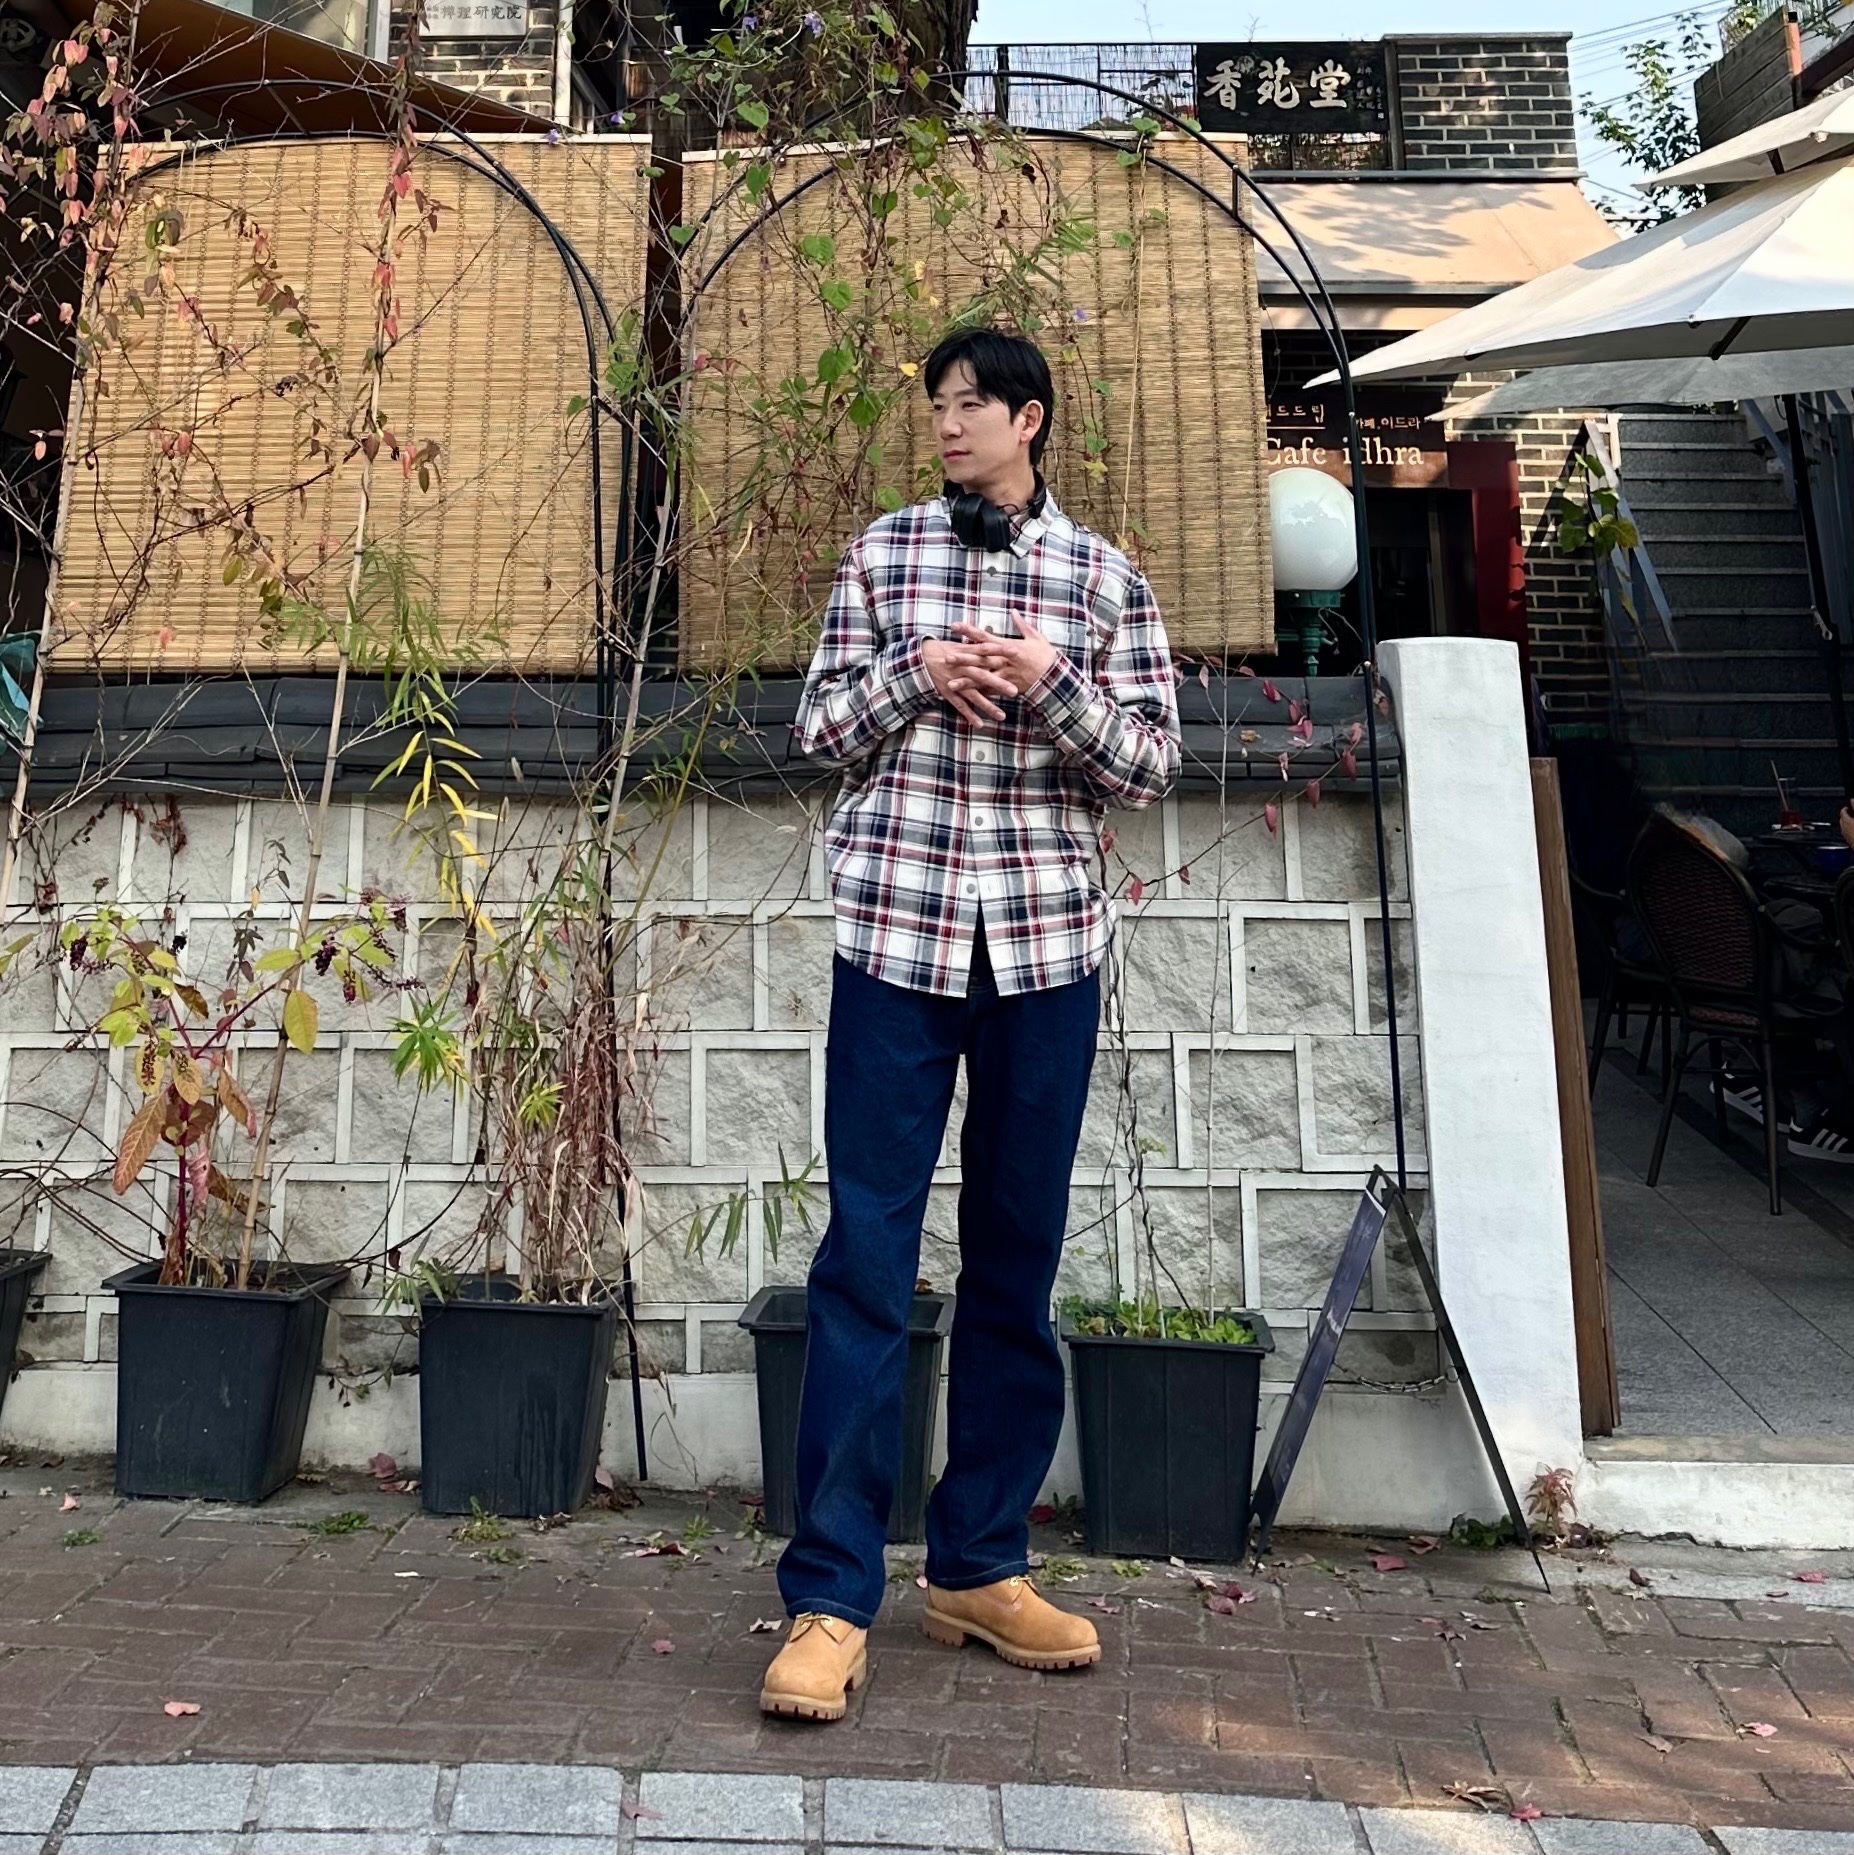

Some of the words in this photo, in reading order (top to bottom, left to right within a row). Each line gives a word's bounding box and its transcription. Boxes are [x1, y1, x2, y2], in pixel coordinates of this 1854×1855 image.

[1203, 56, 1352, 111] 香苑堂
[1265, 436, 1327, 466] Cafe
